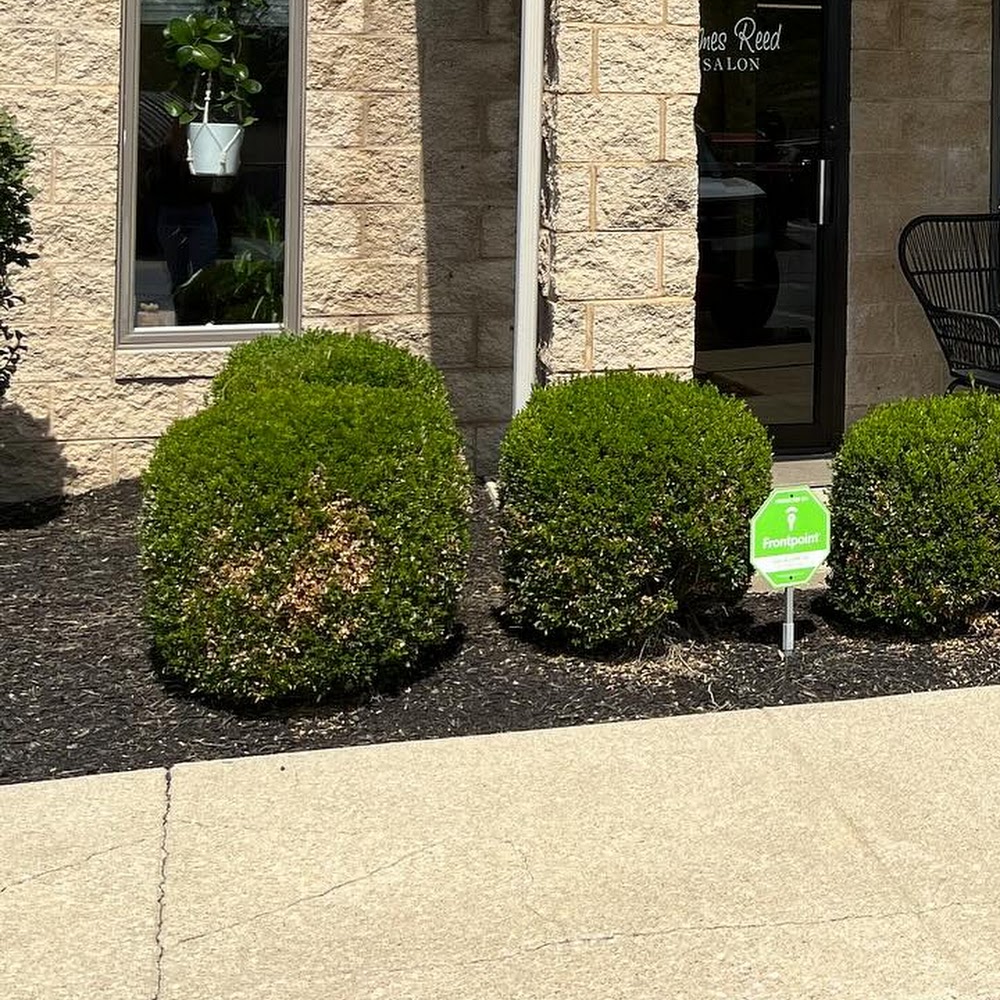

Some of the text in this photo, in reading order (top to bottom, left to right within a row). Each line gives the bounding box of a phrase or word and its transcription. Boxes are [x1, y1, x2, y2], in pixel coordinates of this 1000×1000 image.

[699, 16, 783, 53] mes Reed
[702, 56, 760, 72] SALON
[762, 531, 820, 550] Frontpoint
